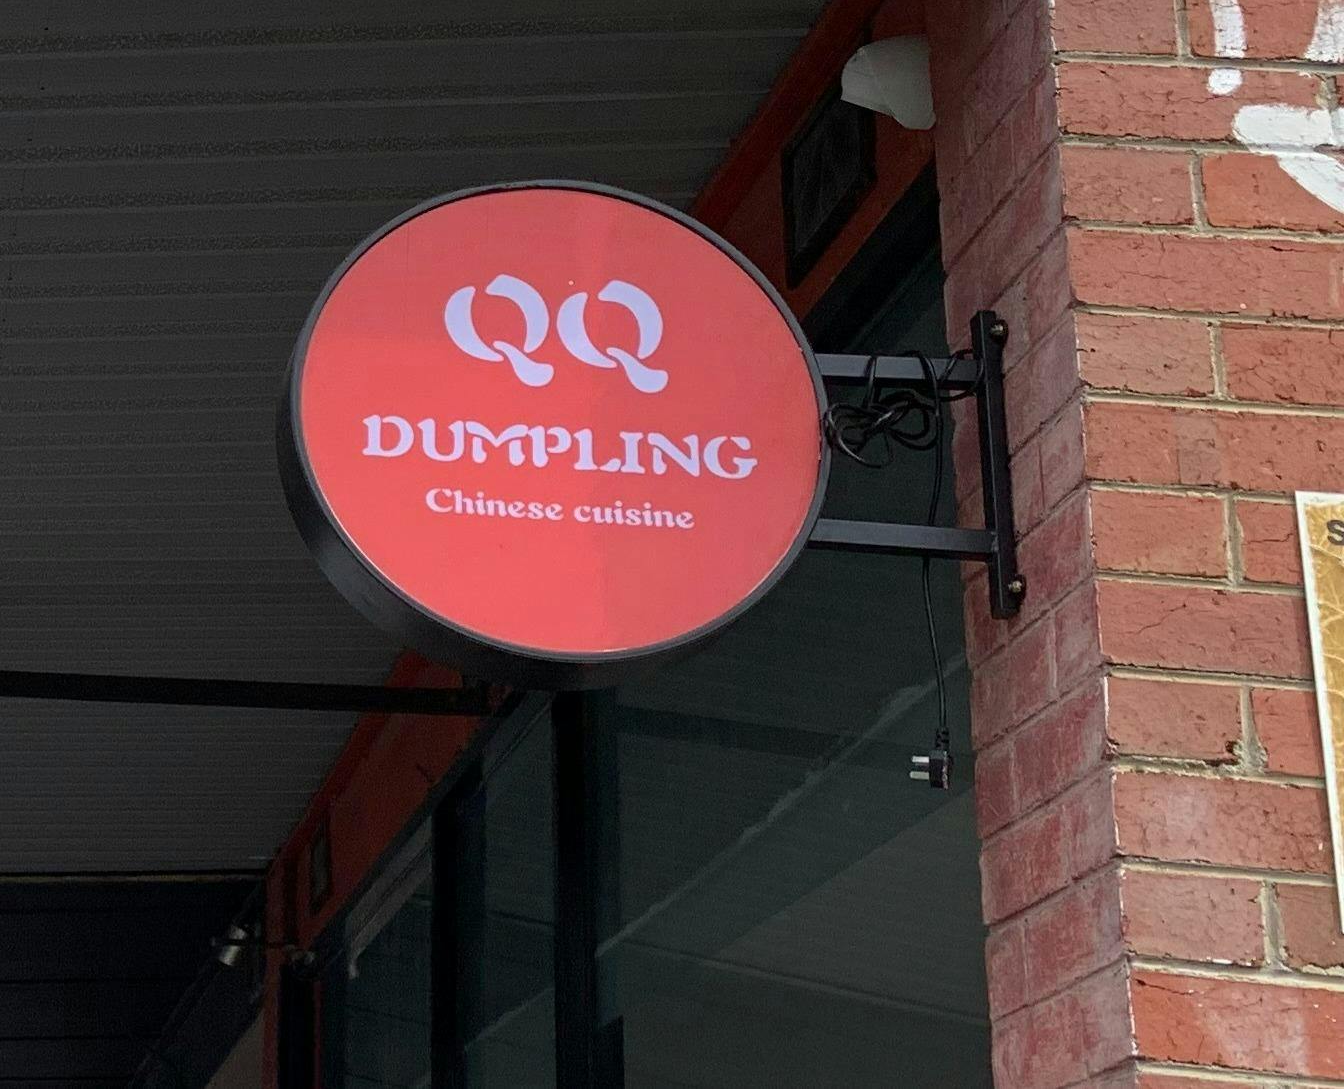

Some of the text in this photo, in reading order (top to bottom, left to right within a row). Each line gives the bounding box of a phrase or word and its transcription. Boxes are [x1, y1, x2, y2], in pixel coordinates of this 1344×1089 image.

[444, 273, 669, 394] QQ
[362, 414, 758, 479] DUMPLING
[425, 488, 695, 529] Chinese cuisine
